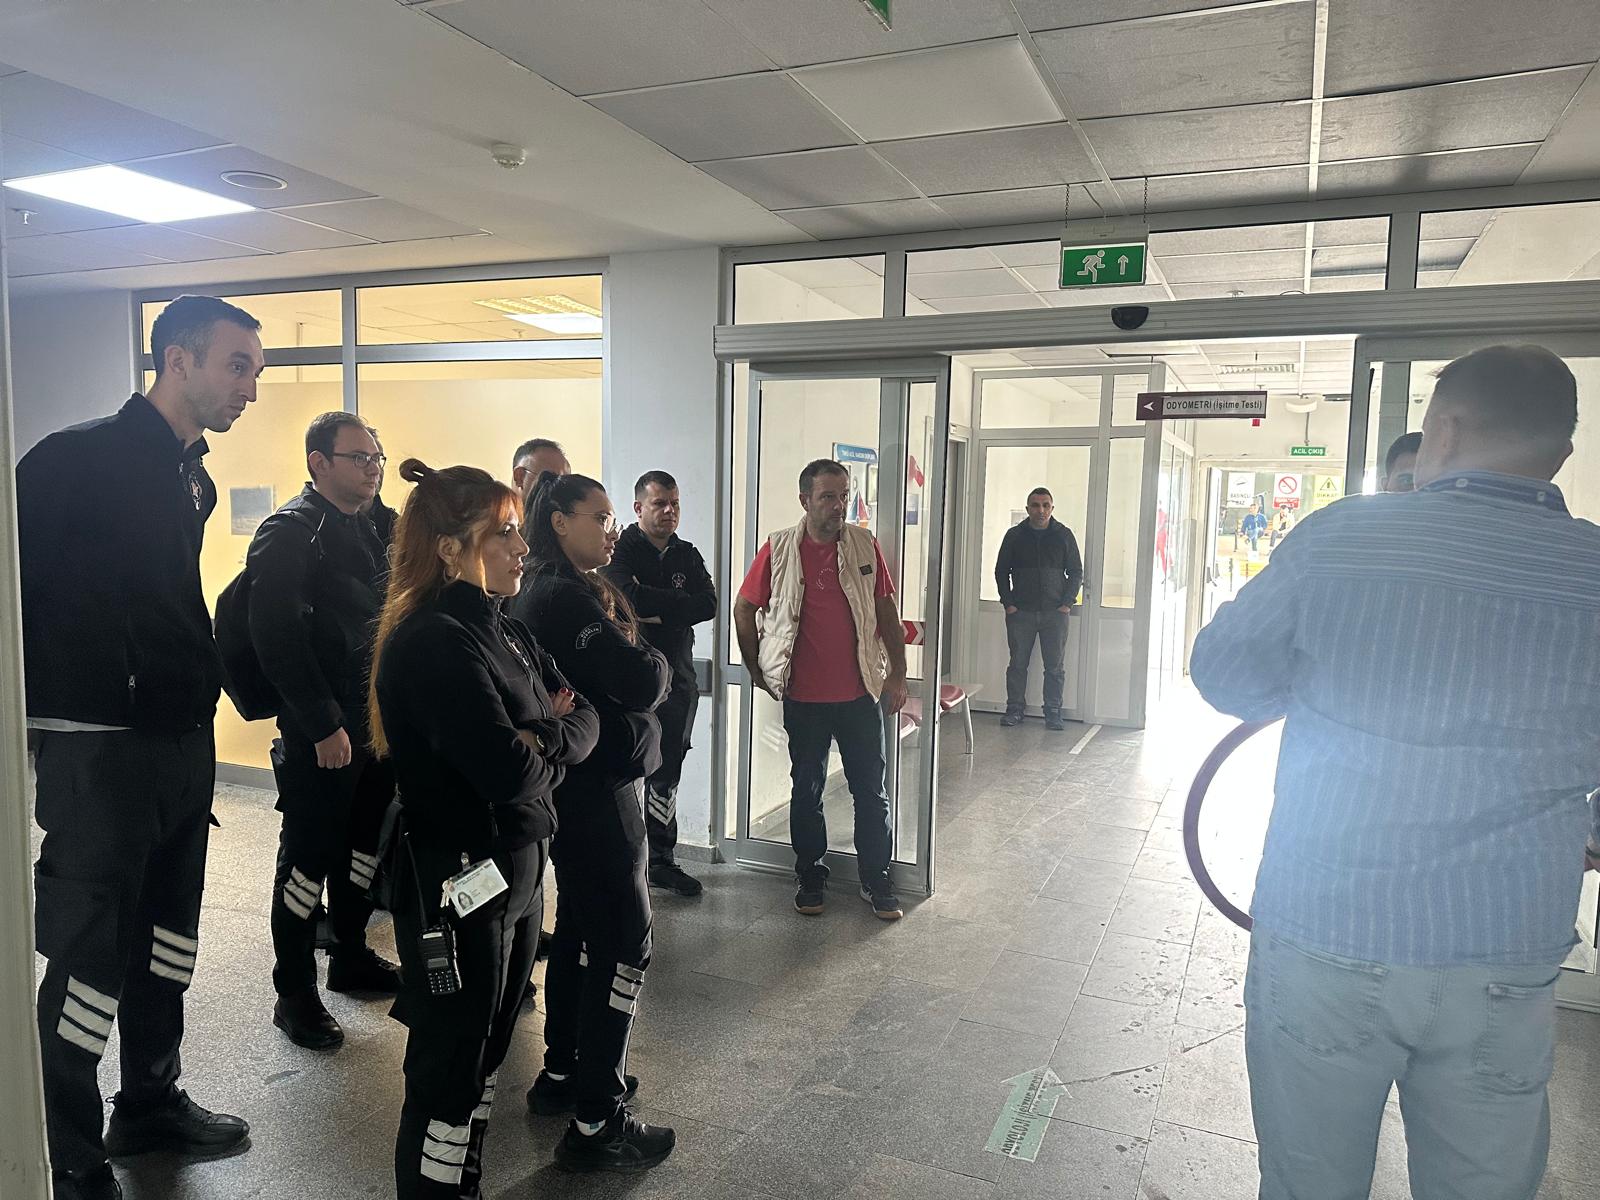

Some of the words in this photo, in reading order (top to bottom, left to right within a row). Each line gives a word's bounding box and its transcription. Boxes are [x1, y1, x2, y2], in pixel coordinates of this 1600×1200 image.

[1166, 399, 1212, 410] ODYOMETRİ
[1213, 398, 1240, 411] (İşitme
[1241, 399, 1262, 410] Testi)
